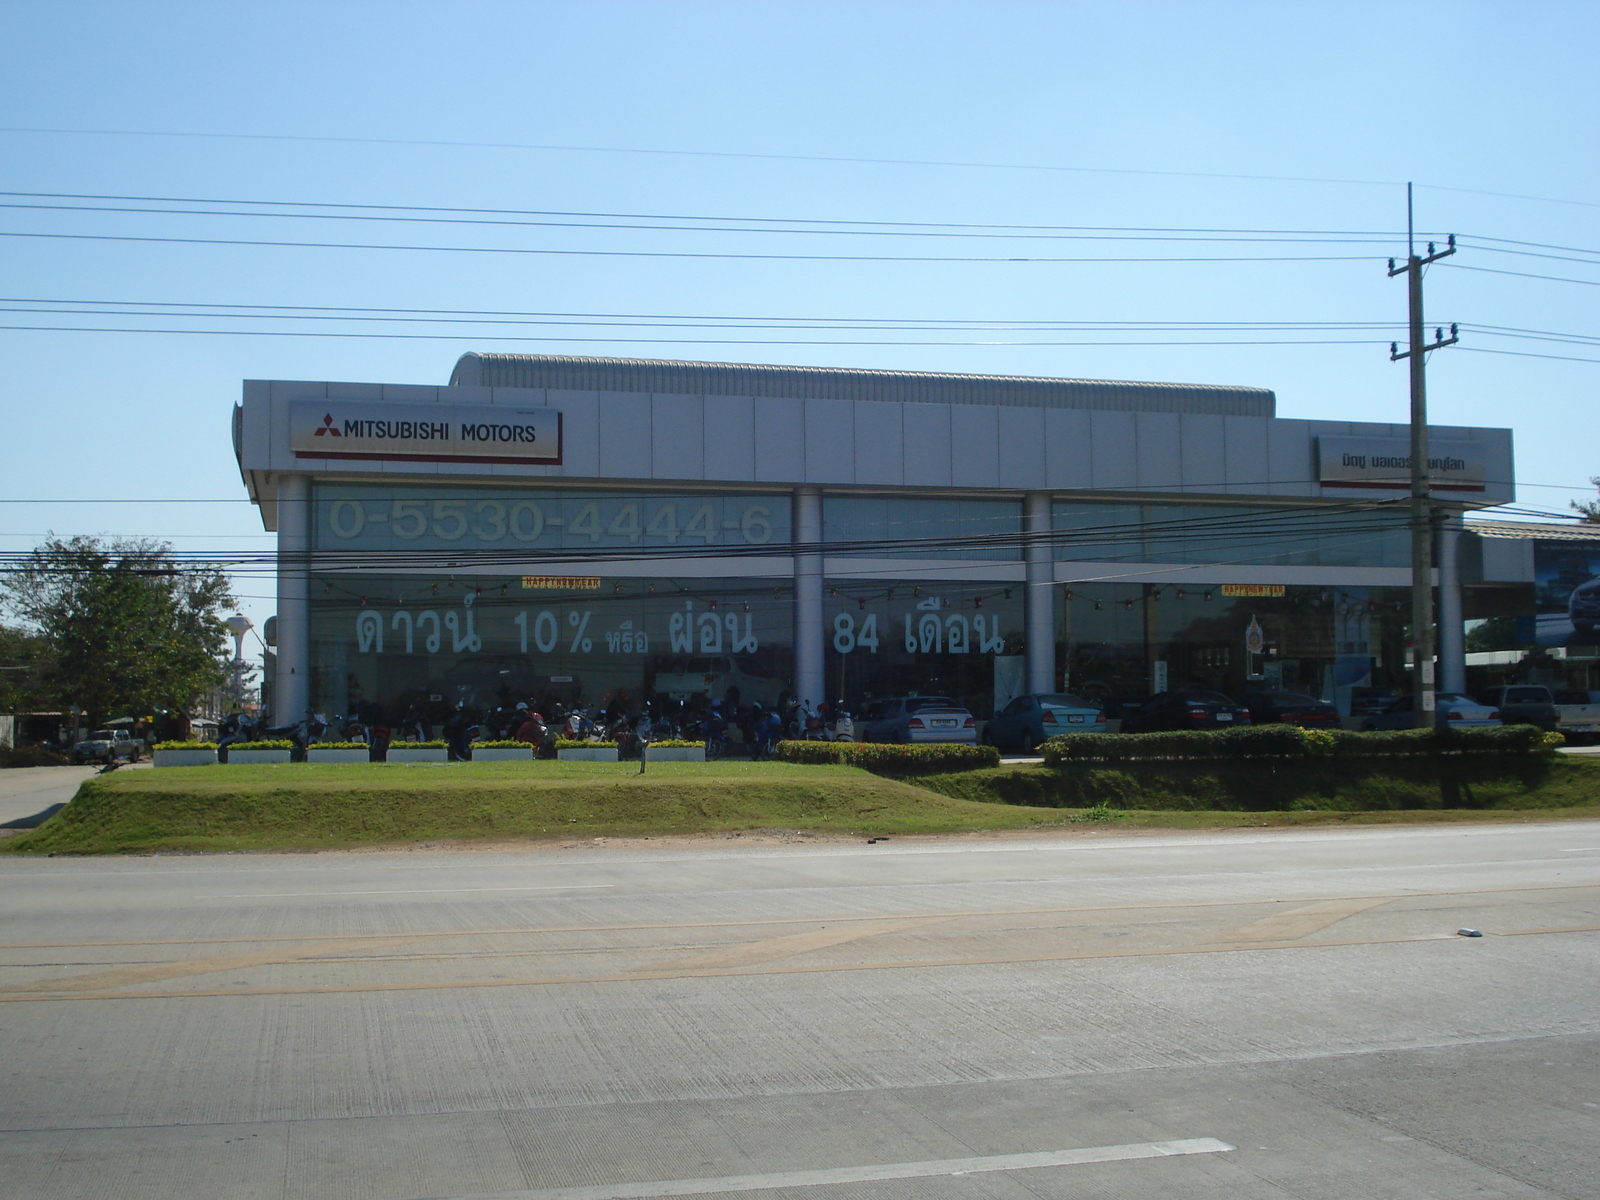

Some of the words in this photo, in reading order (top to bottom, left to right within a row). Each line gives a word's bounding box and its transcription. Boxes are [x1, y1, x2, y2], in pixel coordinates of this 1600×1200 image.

[344, 419, 449, 440] MITSUBISHI
[461, 423, 536, 443] MOTORS
[329, 498, 773, 545] 0-5530-4444-6
[526, 577, 556, 586] HAPPY
[356, 592, 482, 653] ดาวน์
[605, 620, 648, 653] หรือ
[669, 600, 759, 654] ผ่อน
[833, 612, 879, 654] 84
[905, 596, 1005, 654] เดือน
